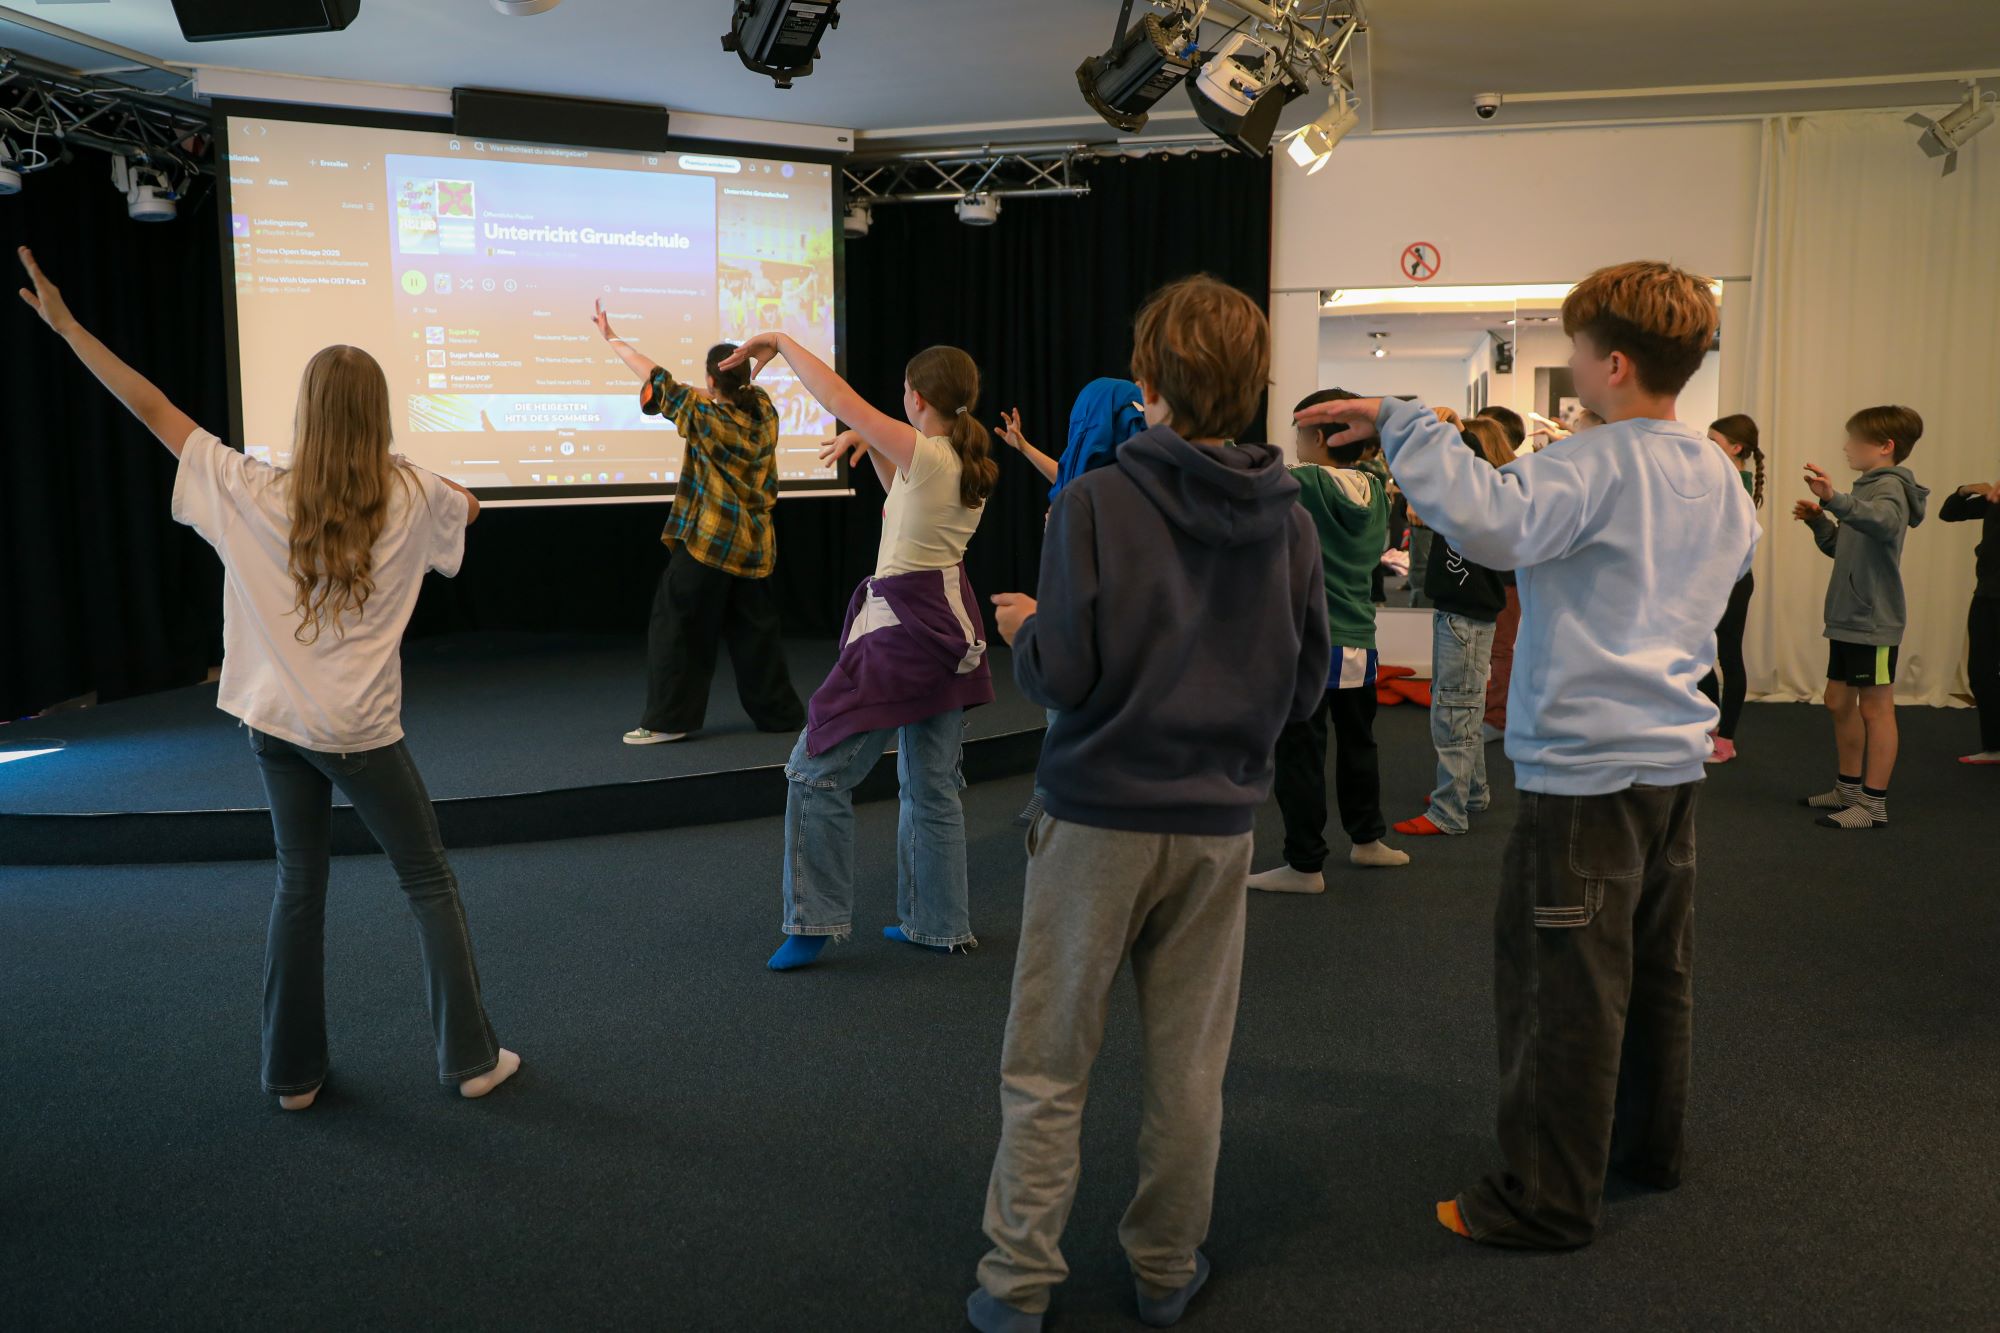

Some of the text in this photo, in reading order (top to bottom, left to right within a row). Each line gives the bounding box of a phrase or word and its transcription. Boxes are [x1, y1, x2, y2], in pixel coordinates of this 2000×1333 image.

[320, 159, 349, 168] Erstellen
[724, 187, 789, 199] Unterricht Grundschule
[254, 218, 309, 228] Lieblingssongs
[484, 221, 691, 250] Unterricht Grundschule
[279, 248, 299, 257] Open
[300, 249, 320, 257] Stage
[266, 275, 279, 283] You
[298, 277, 318, 285] Upon
[330, 277, 345, 285] OST
[449, 352, 468, 361] Sugar
[450, 374, 491, 383] Feel the POP
[514, 402, 532, 412] DIE
[504, 413, 601, 423] HITS DES SOMMERS
